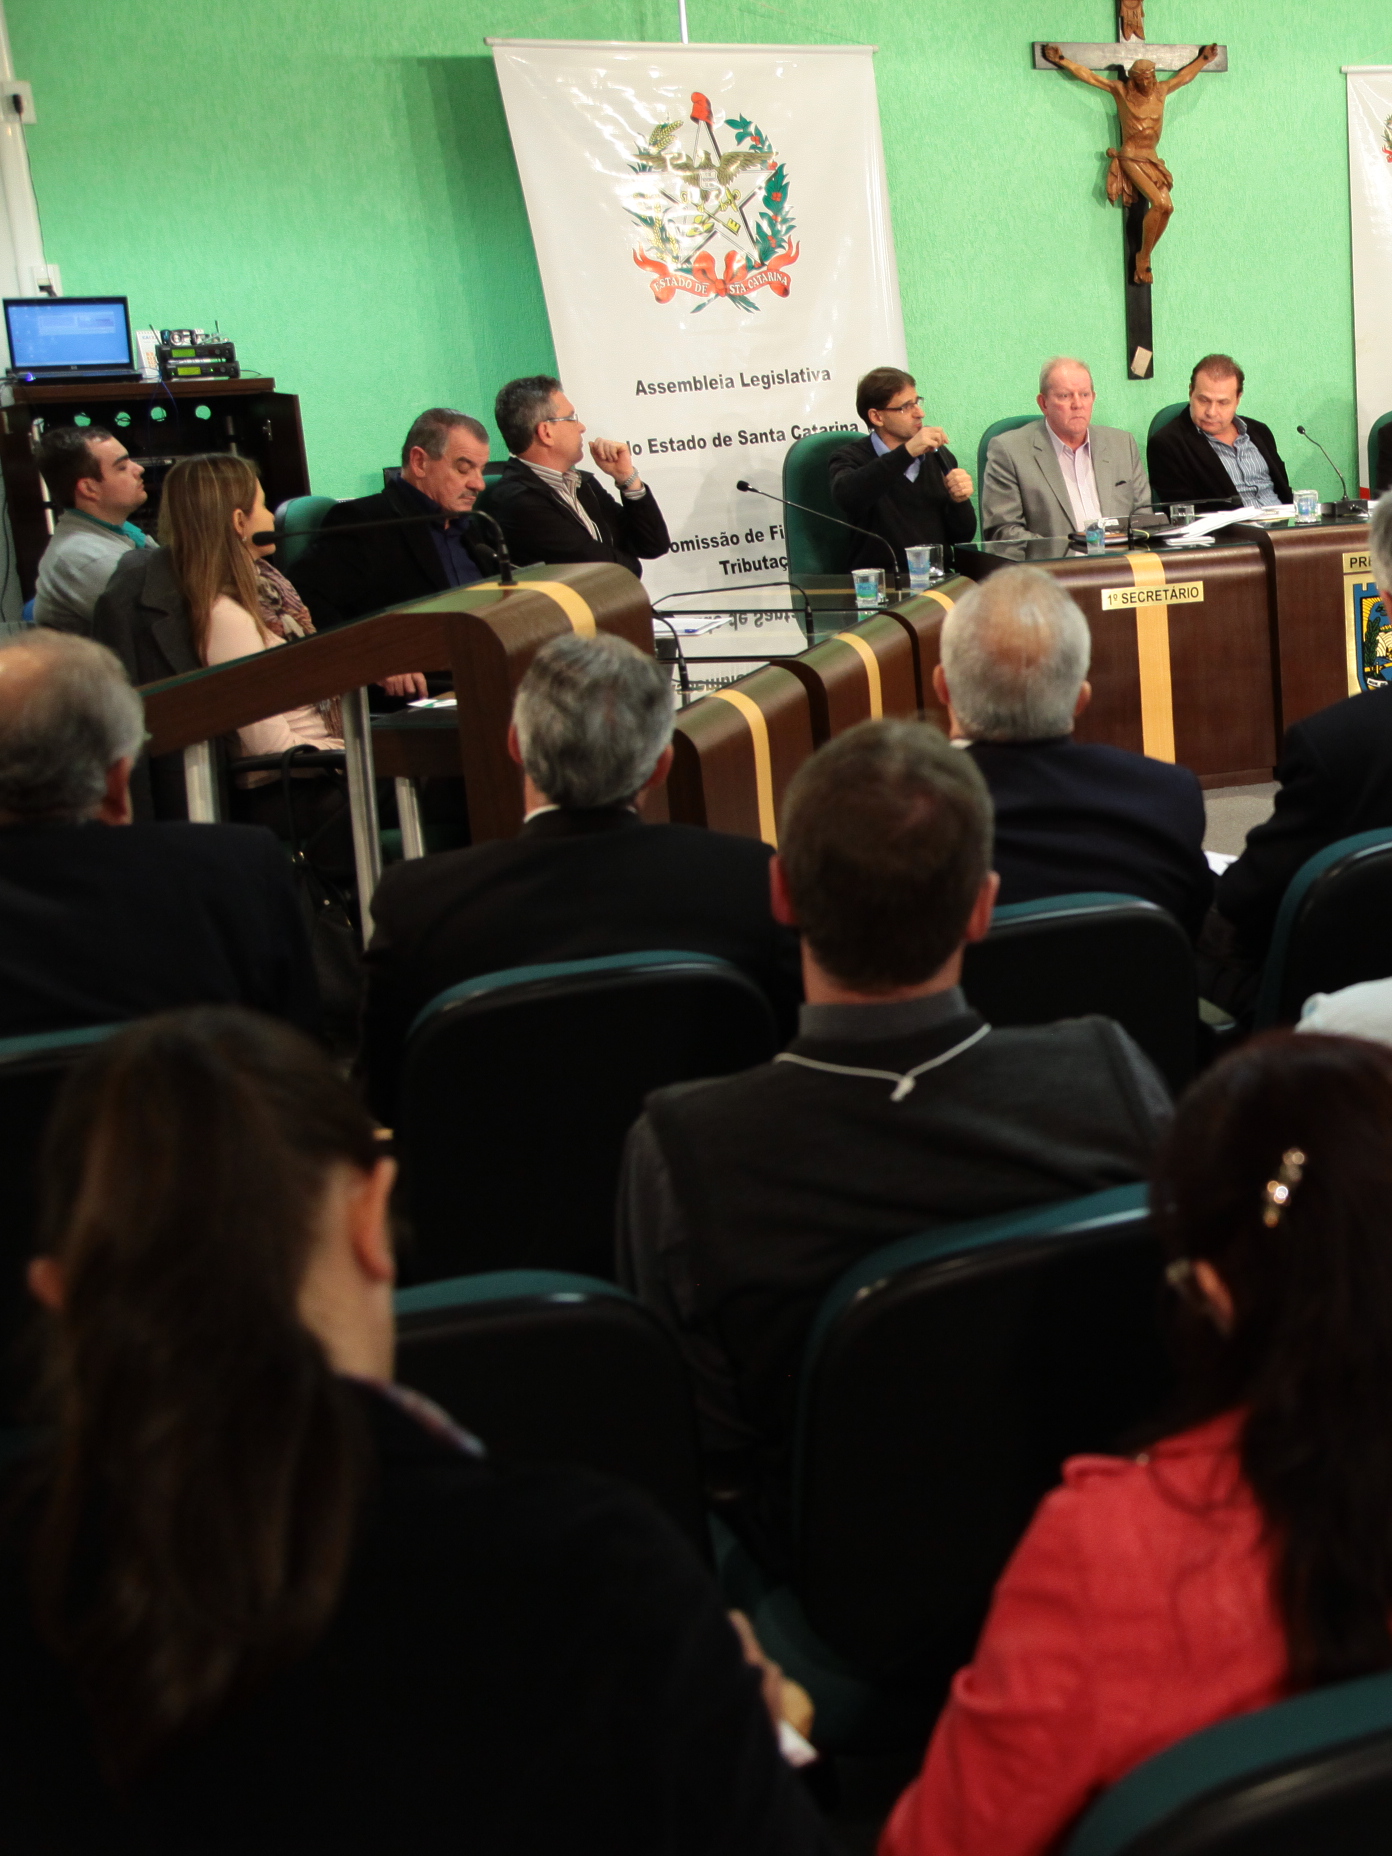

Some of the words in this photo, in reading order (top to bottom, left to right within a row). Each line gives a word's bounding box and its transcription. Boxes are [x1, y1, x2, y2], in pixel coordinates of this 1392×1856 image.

[653, 276, 692, 292] ESTADO
[694, 282, 708, 295] DE
[748, 271, 789, 289] CATARINA
[635, 373, 735, 397] Assembleia
[739, 367, 832, 391] Legislativa
[647, 434, 707, 455] Estado
[712, 431, 733, 448] de
[737, 428, 787, 446] Santa
[669, 532, 740, 554] omissão
[744, 528, 765, 544] de
[718, 555, 789, 576] Tributaç
[1107, 593, 1118, 606] 1º
[1121, 586, 1199, 605] SECRETÁRIO
